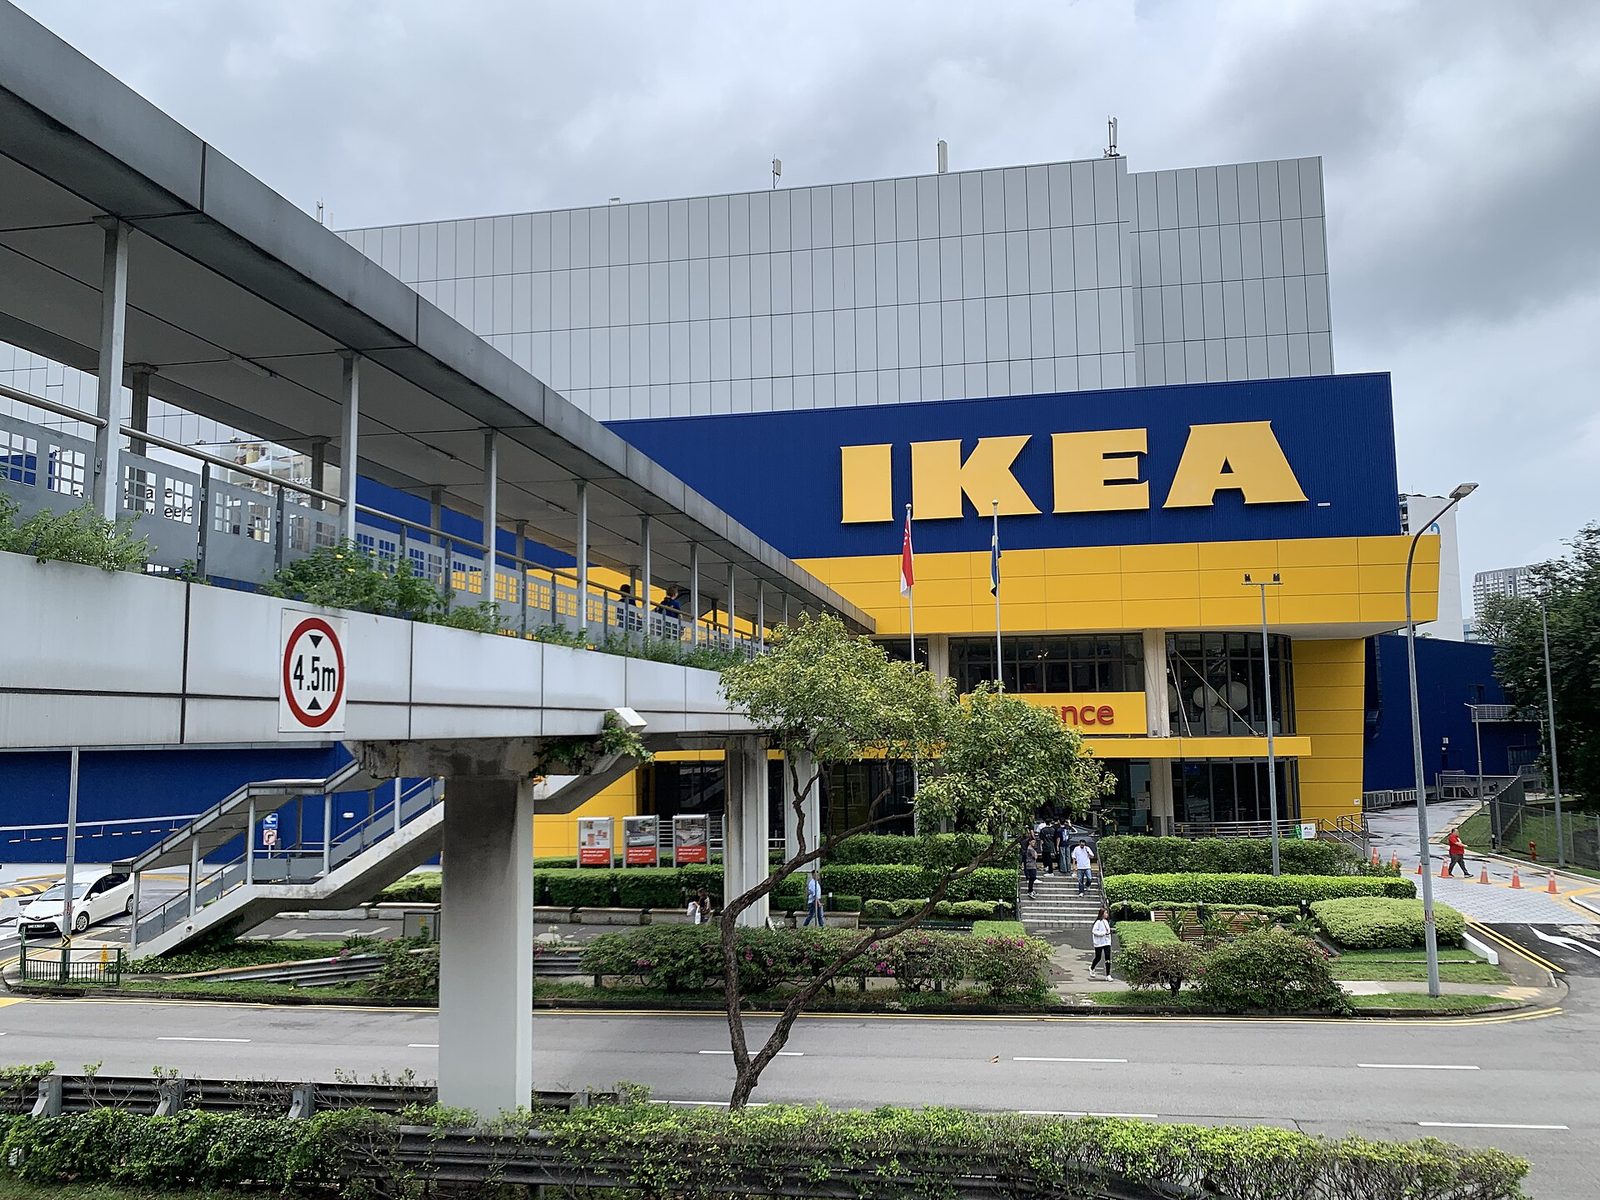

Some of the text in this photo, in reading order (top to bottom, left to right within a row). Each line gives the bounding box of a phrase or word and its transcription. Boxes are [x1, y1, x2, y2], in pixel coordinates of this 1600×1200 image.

[840, 420, 1310, 524] IKEA
[293, 654, 336, 692] 4.5m
[1053, 705, 1114, 726] nce
